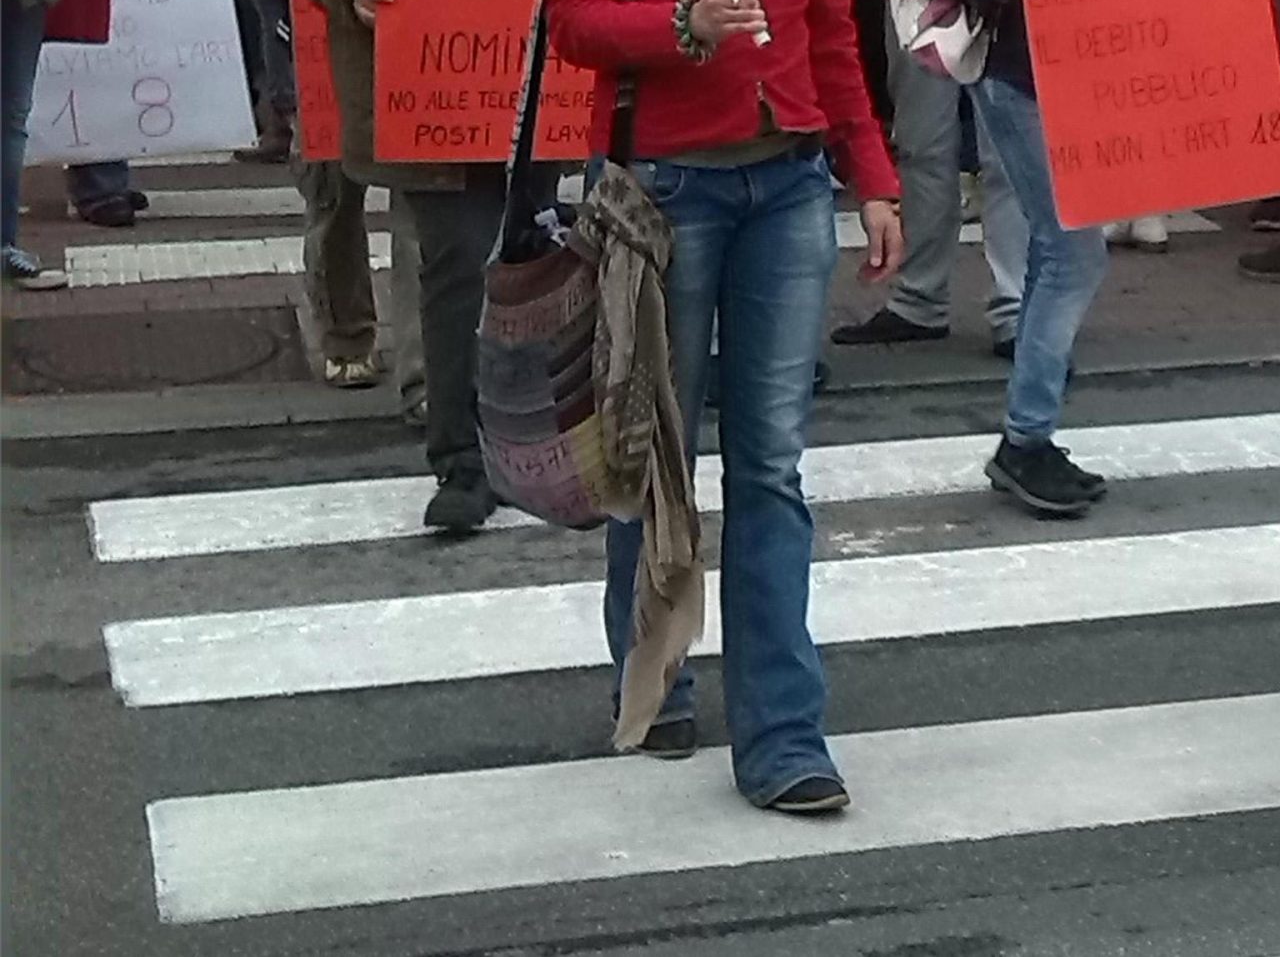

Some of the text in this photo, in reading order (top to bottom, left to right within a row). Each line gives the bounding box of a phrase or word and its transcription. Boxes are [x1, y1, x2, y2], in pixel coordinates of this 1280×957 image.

[1073, 17, 1169, 60] DEBITO
[387, 91, 416, 114] NO
[425, 90, 469, 112] ALLE
[1092, 64, 1239, 111] PUBBLICO
[414, 122, 490, 147] POSTI
[1095, 134, 1143, 169] NON
